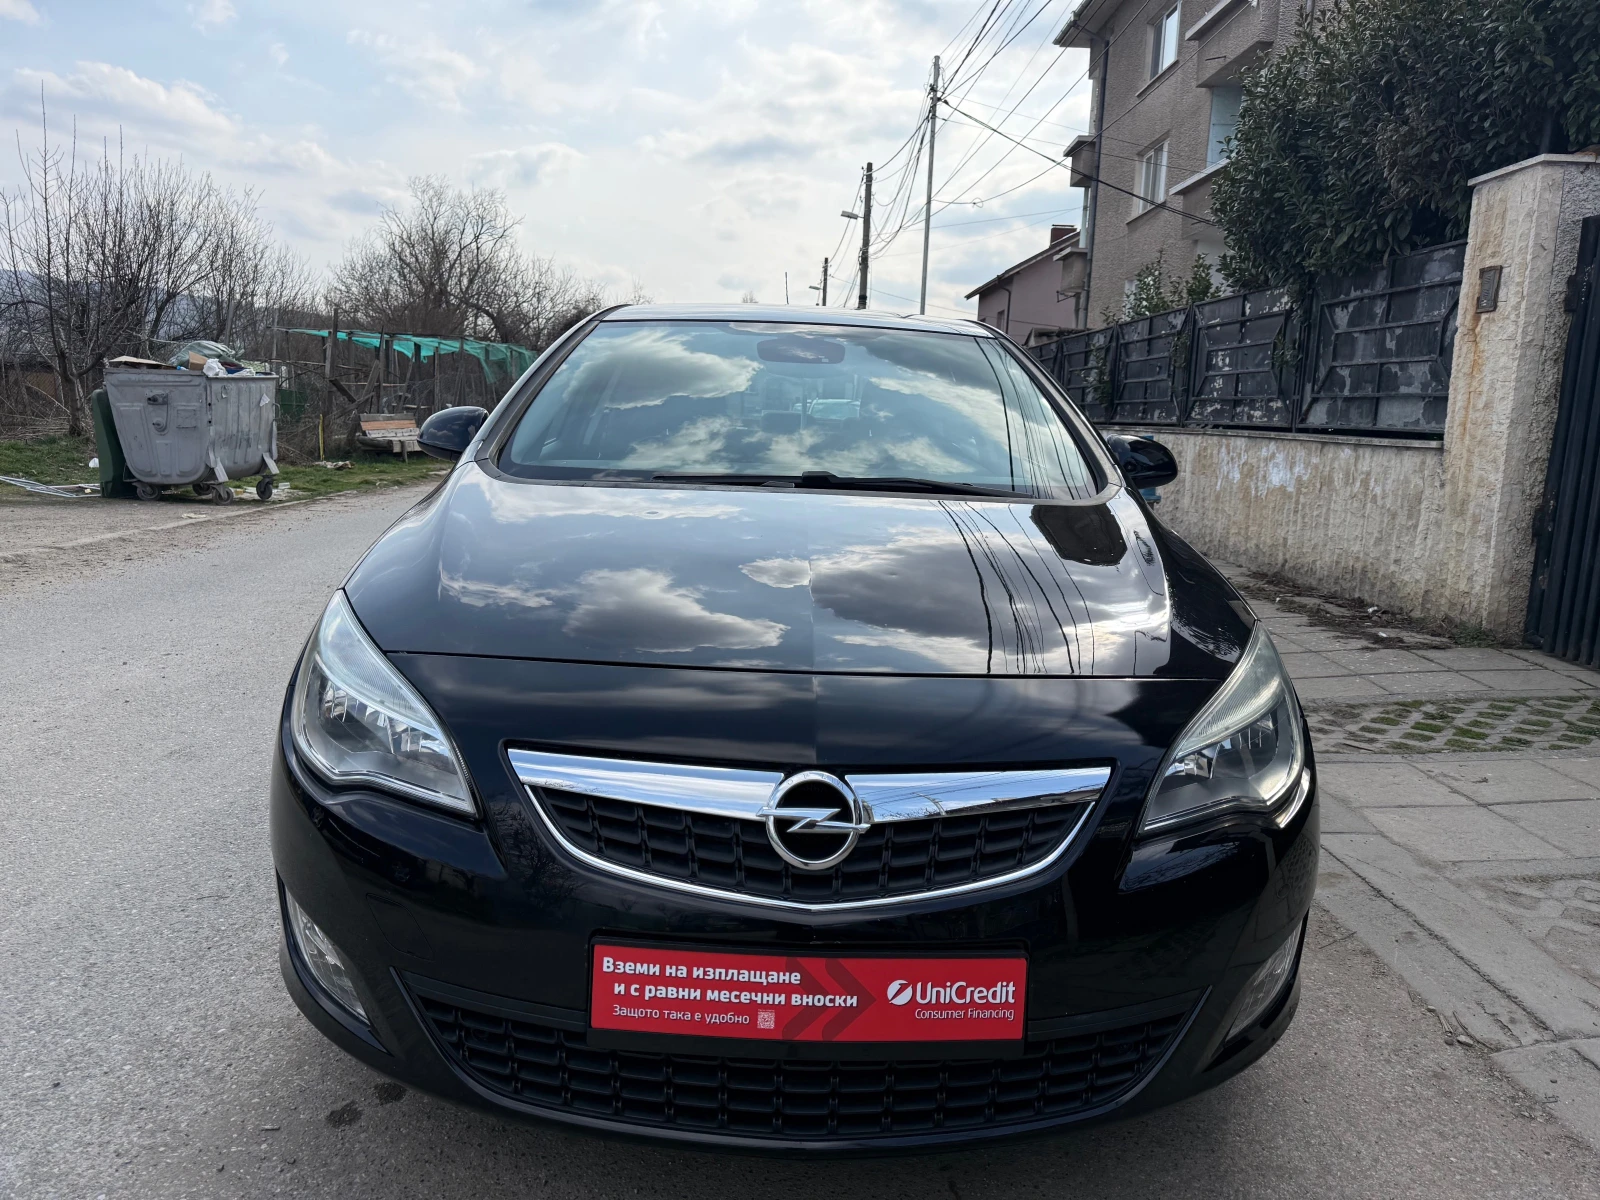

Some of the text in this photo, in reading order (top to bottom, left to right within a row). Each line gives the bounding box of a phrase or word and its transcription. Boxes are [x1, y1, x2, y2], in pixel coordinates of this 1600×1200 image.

[603, 957, 801, 985] Вземи на изплащане
[614, 983, 858, 1007] и с равни месечни вноски
[916, 981, 1015, 1004] UniCredit
[613, 1004, 750, 1024] Защото така е удобно
[915, 1008, 1015, 1020] Consumer Financing
